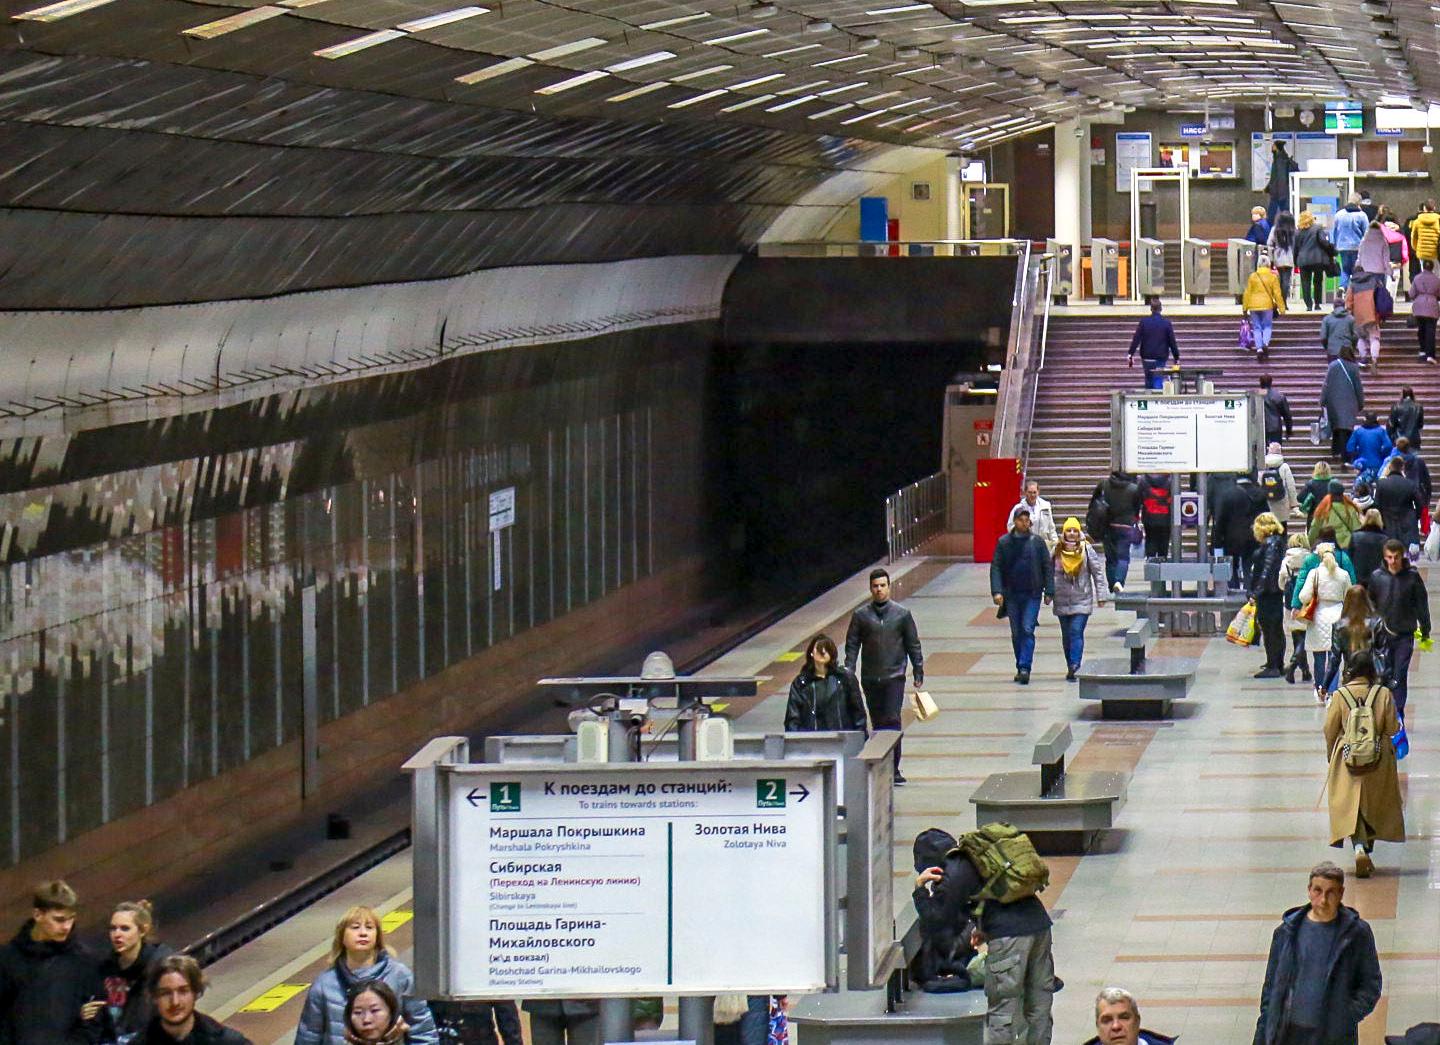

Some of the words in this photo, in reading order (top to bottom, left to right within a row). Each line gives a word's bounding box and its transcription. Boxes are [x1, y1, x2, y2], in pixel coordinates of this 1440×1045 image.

[499, 784, 512, 803] 1
[544, 782, 555, 795] К
[561, 783, 630, 797] поездам
[635, 783, 656, 797] до
[661, 779, 732, 795] станций:
[765, 781, 778, 800] 2
[579, 800, 589, 809] To
[592, 799, 617, 809] trains
[620, 799, 656, 809] towards
[659, 799, 698, 808] stations:
[490, 827, 553, 841] Маршала
[557, 826, 646, 840] Покрышкина
[695, 823, 749, 835] Золотая
[753, 822, 786, 834] Нива
[490, 842, 532, 852] Marshala
[535, 841, 591, 853] Pokryshkina
[724, 839, 763, 850] Zolotaya
[766, 839, 787, 848] Niva
[489, 861, 562, 875] Сибирская
[490, 878, 534, 889] (Переход
[550, 878, 604, 888] Ленинскую
[606, 877, 641, 886] линию)
[489, 891, 536, 901] Sibirskaya
[489, 919, 551, 932] Площадь
[555, 918, 607, 932] Гарина-
[490, 936, 595, 949] Михайловского
[513, 953, 550, 963] вокзал)
[489, 966, 535, 976] Ploshchad
[538, 965, 642, 976] Garina-Mikhailovskogo
